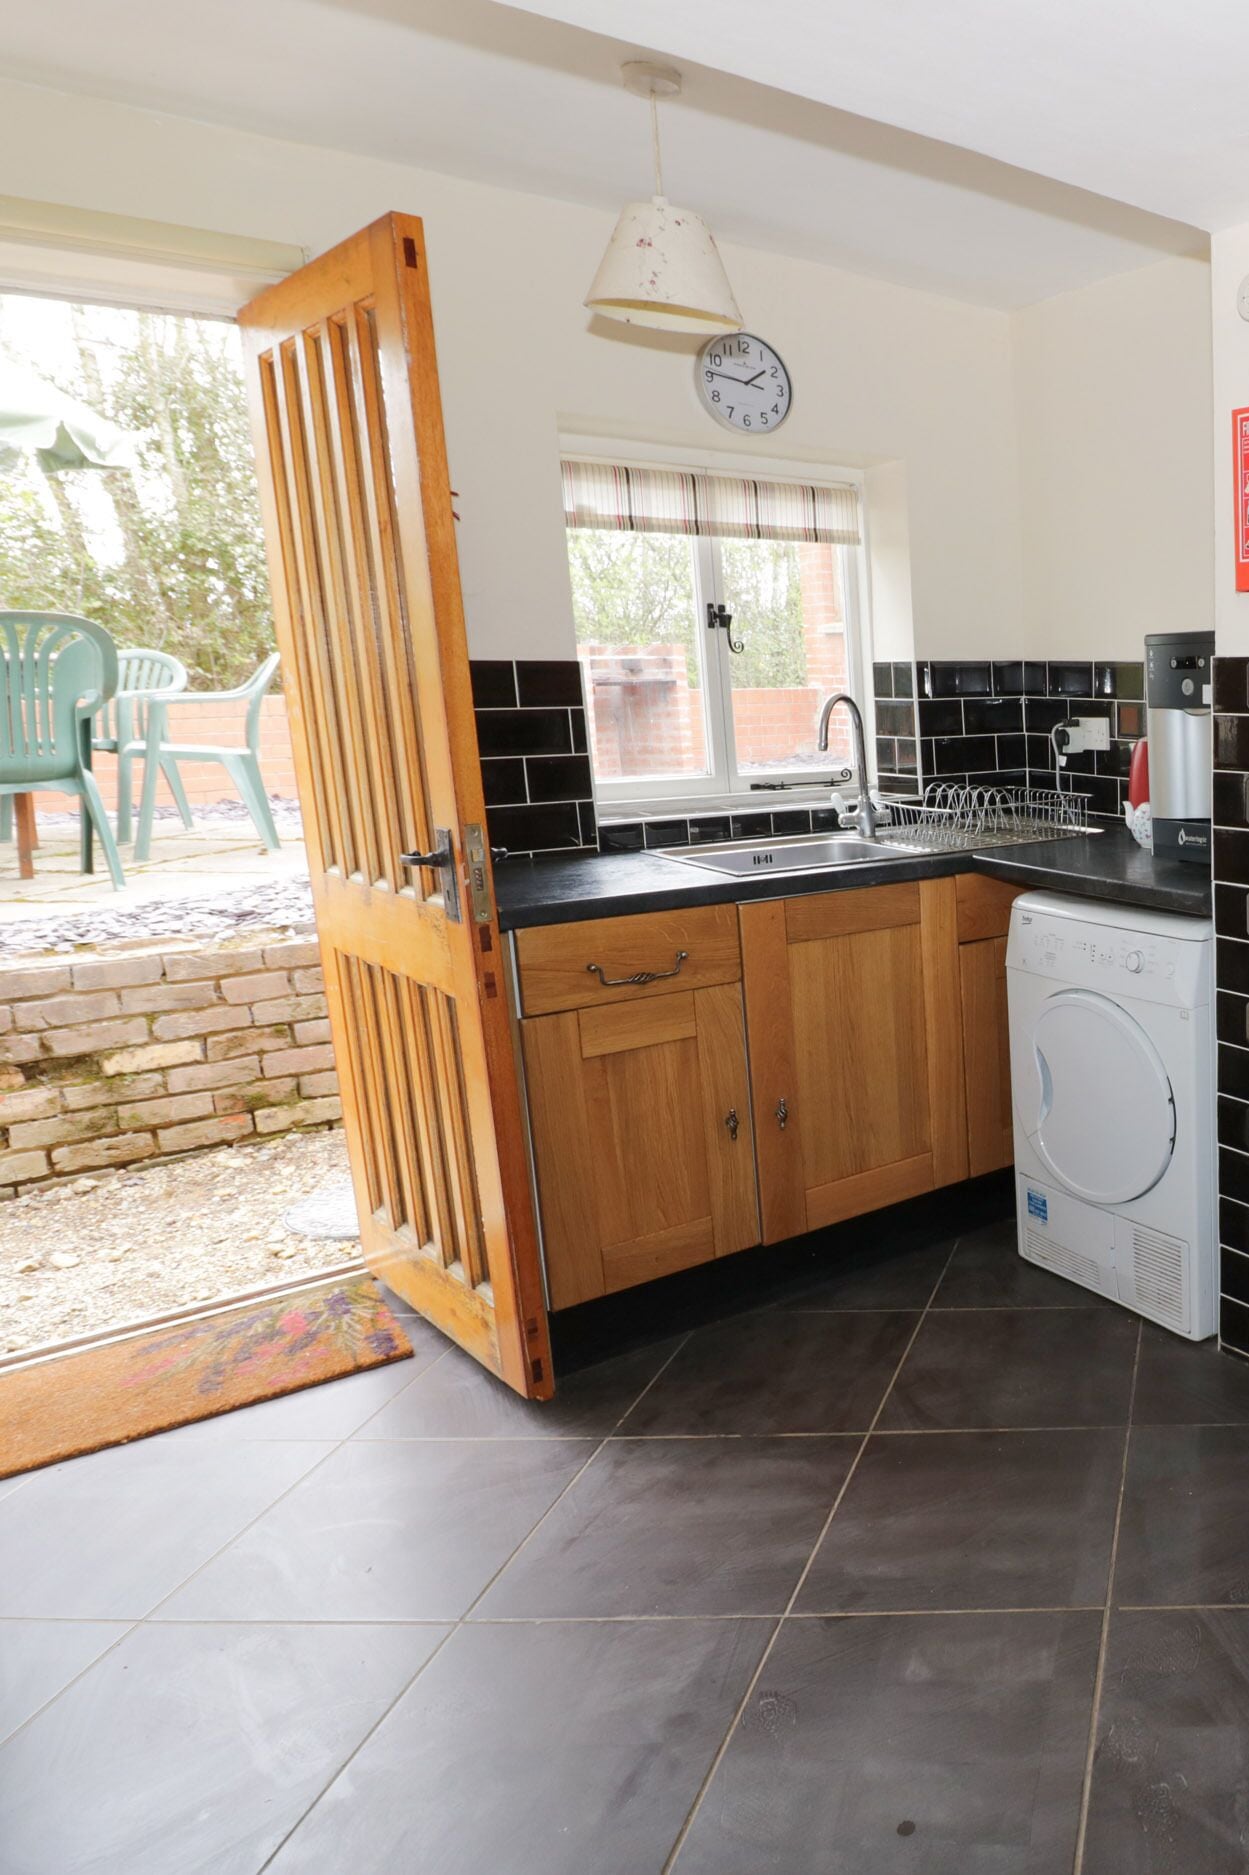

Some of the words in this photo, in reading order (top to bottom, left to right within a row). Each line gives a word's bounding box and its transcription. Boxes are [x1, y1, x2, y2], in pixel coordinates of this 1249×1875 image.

[723, 342, 732, 357] 11
[737, 339, 750, 354] 12
[709, 352, 722, 367] 10
[705, 370, 714, 383] 9
[769, 365, 779, 379] 2
[711, 389, 721, 403] 8
[776, 384, 785, 398] 3
[726, 405, 735, 419] 7
[770, 402, 780, 415] 4
[742, 414, 752, 427] 6
[760, 411, 769, 425] 5
